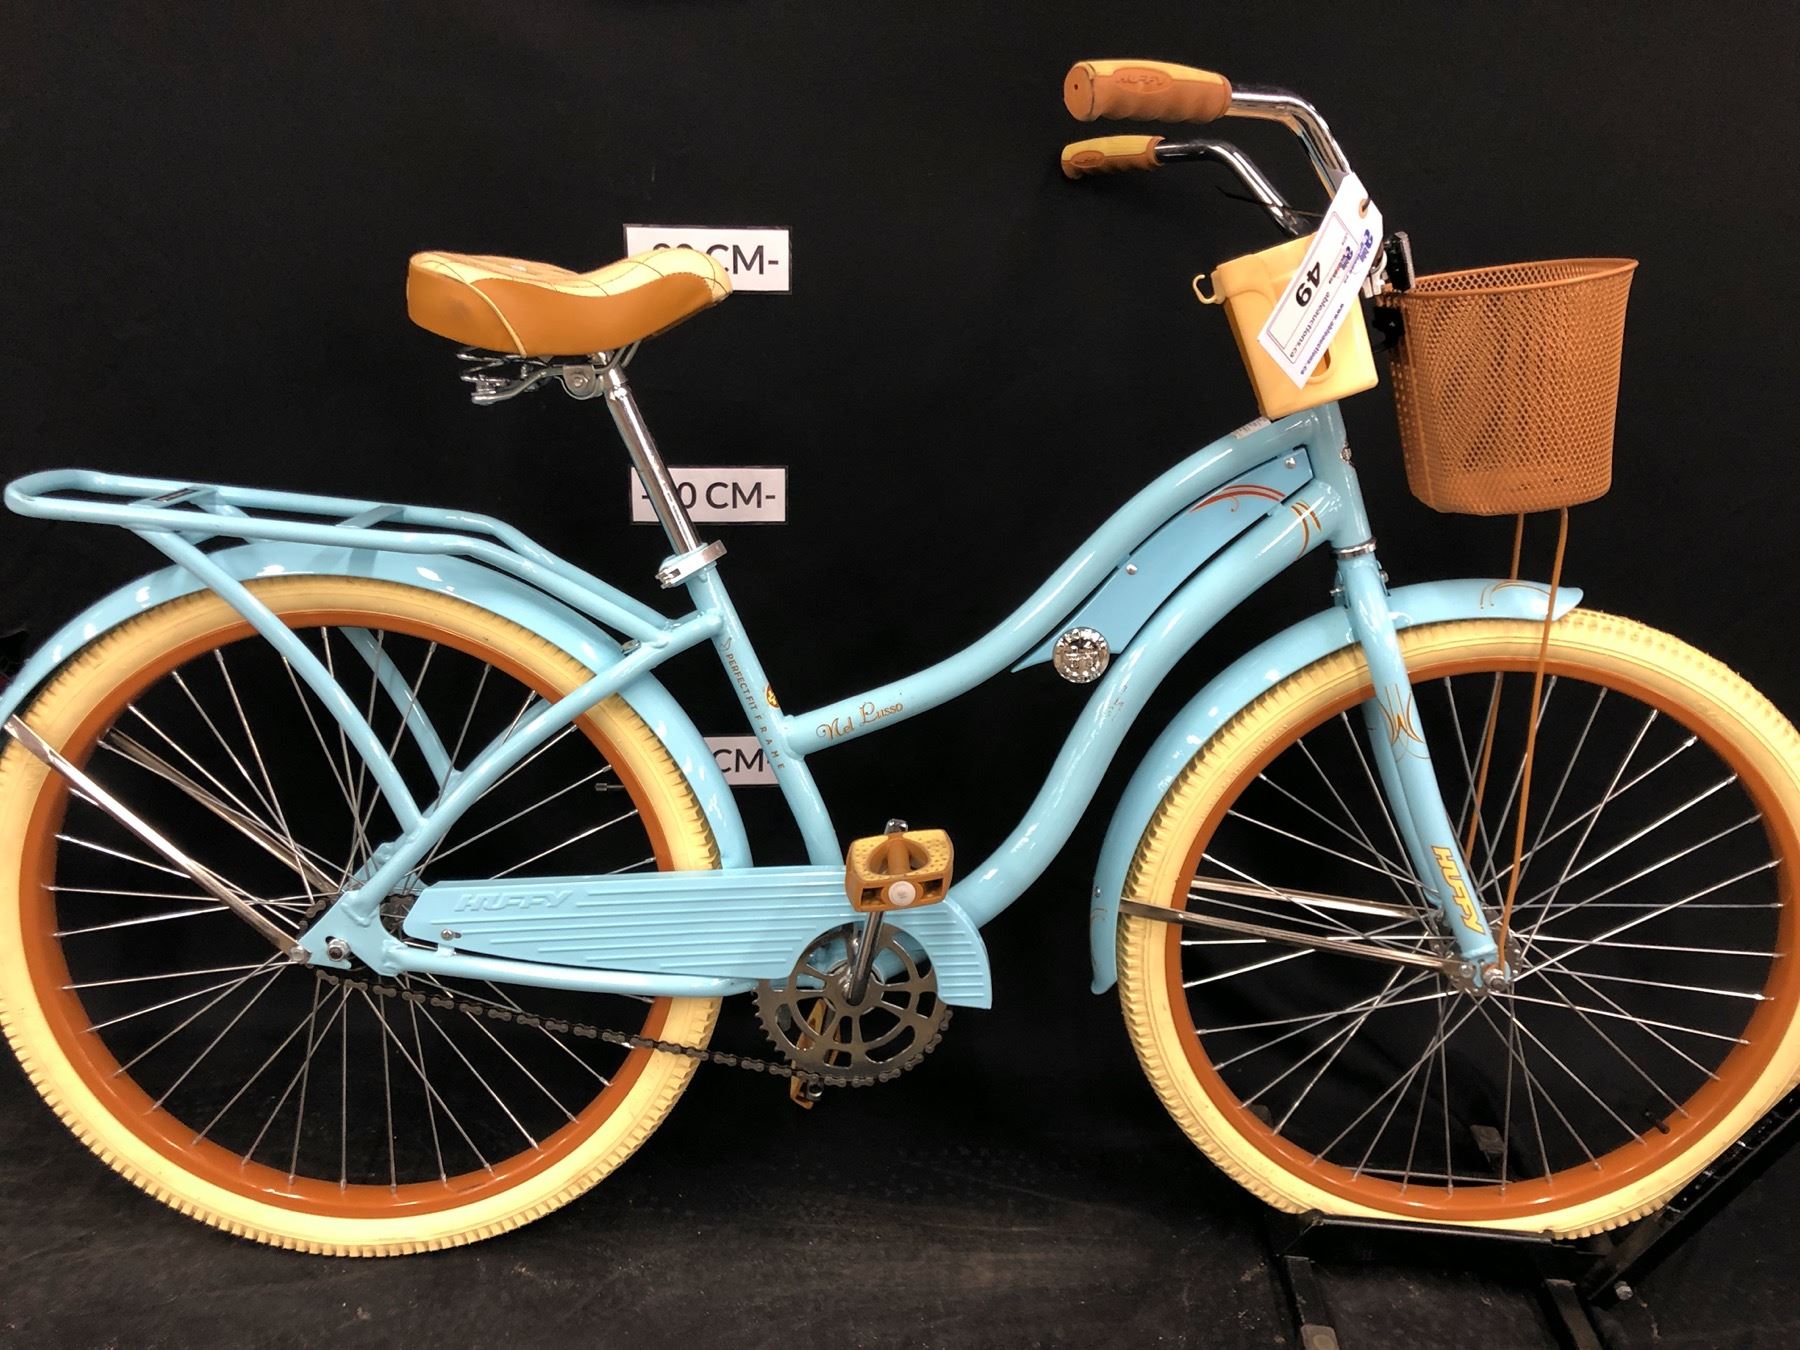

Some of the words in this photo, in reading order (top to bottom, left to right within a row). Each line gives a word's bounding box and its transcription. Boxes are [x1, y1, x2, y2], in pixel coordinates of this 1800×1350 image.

[1295, 261, 1321, 308] 49
[641, 481, 697, 509] -0
[705, 481, 776, 509] CM-
[726, 653, 751, 694] PERFECT
[745, 694, 758, 711] FIT
[755, 713, 785, 770] FRAME
[453, 890, 574, 912] HUFFY
[1430, 845, 1486, 936] HUFFY
